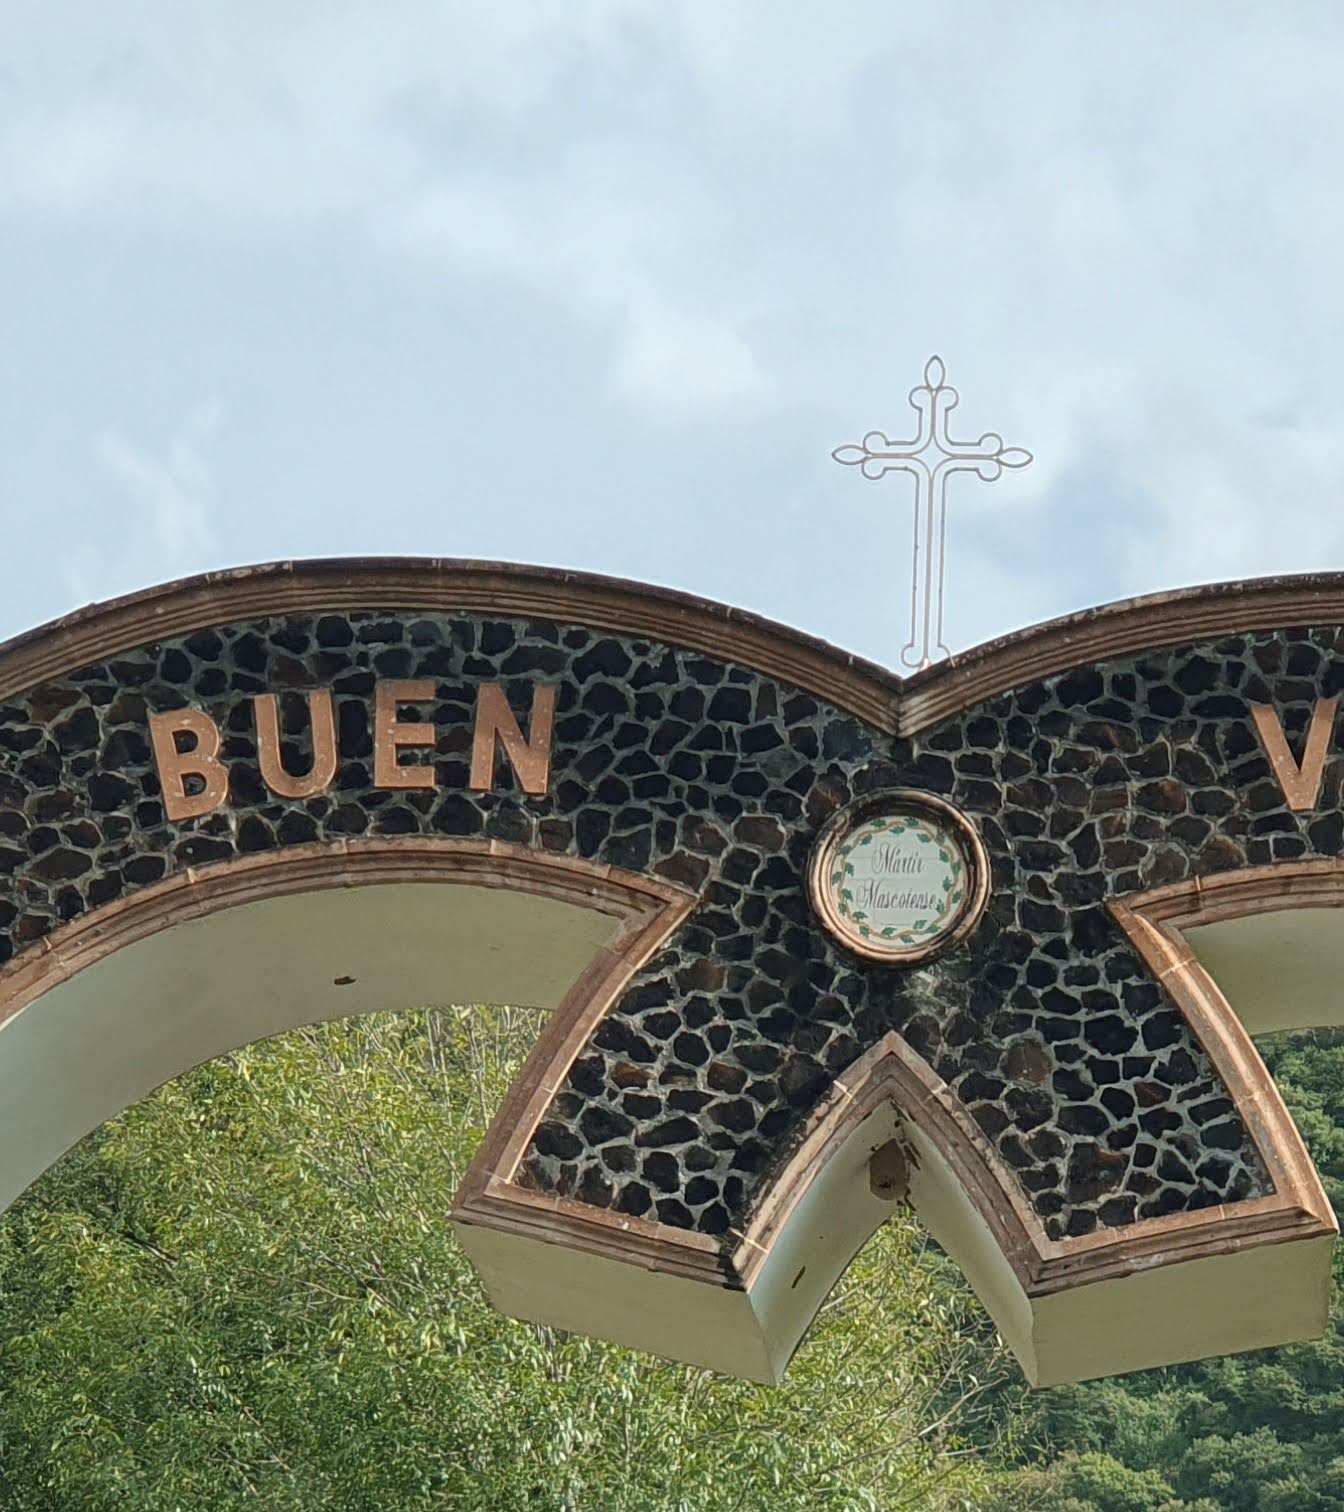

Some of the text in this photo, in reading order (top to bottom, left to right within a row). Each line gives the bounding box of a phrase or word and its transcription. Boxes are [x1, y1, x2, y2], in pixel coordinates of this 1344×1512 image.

[148, 680, 555, 822] BUEN
[871, 841, 924, 875] Mártir
[856, 876, 937, 910] Mascotense
